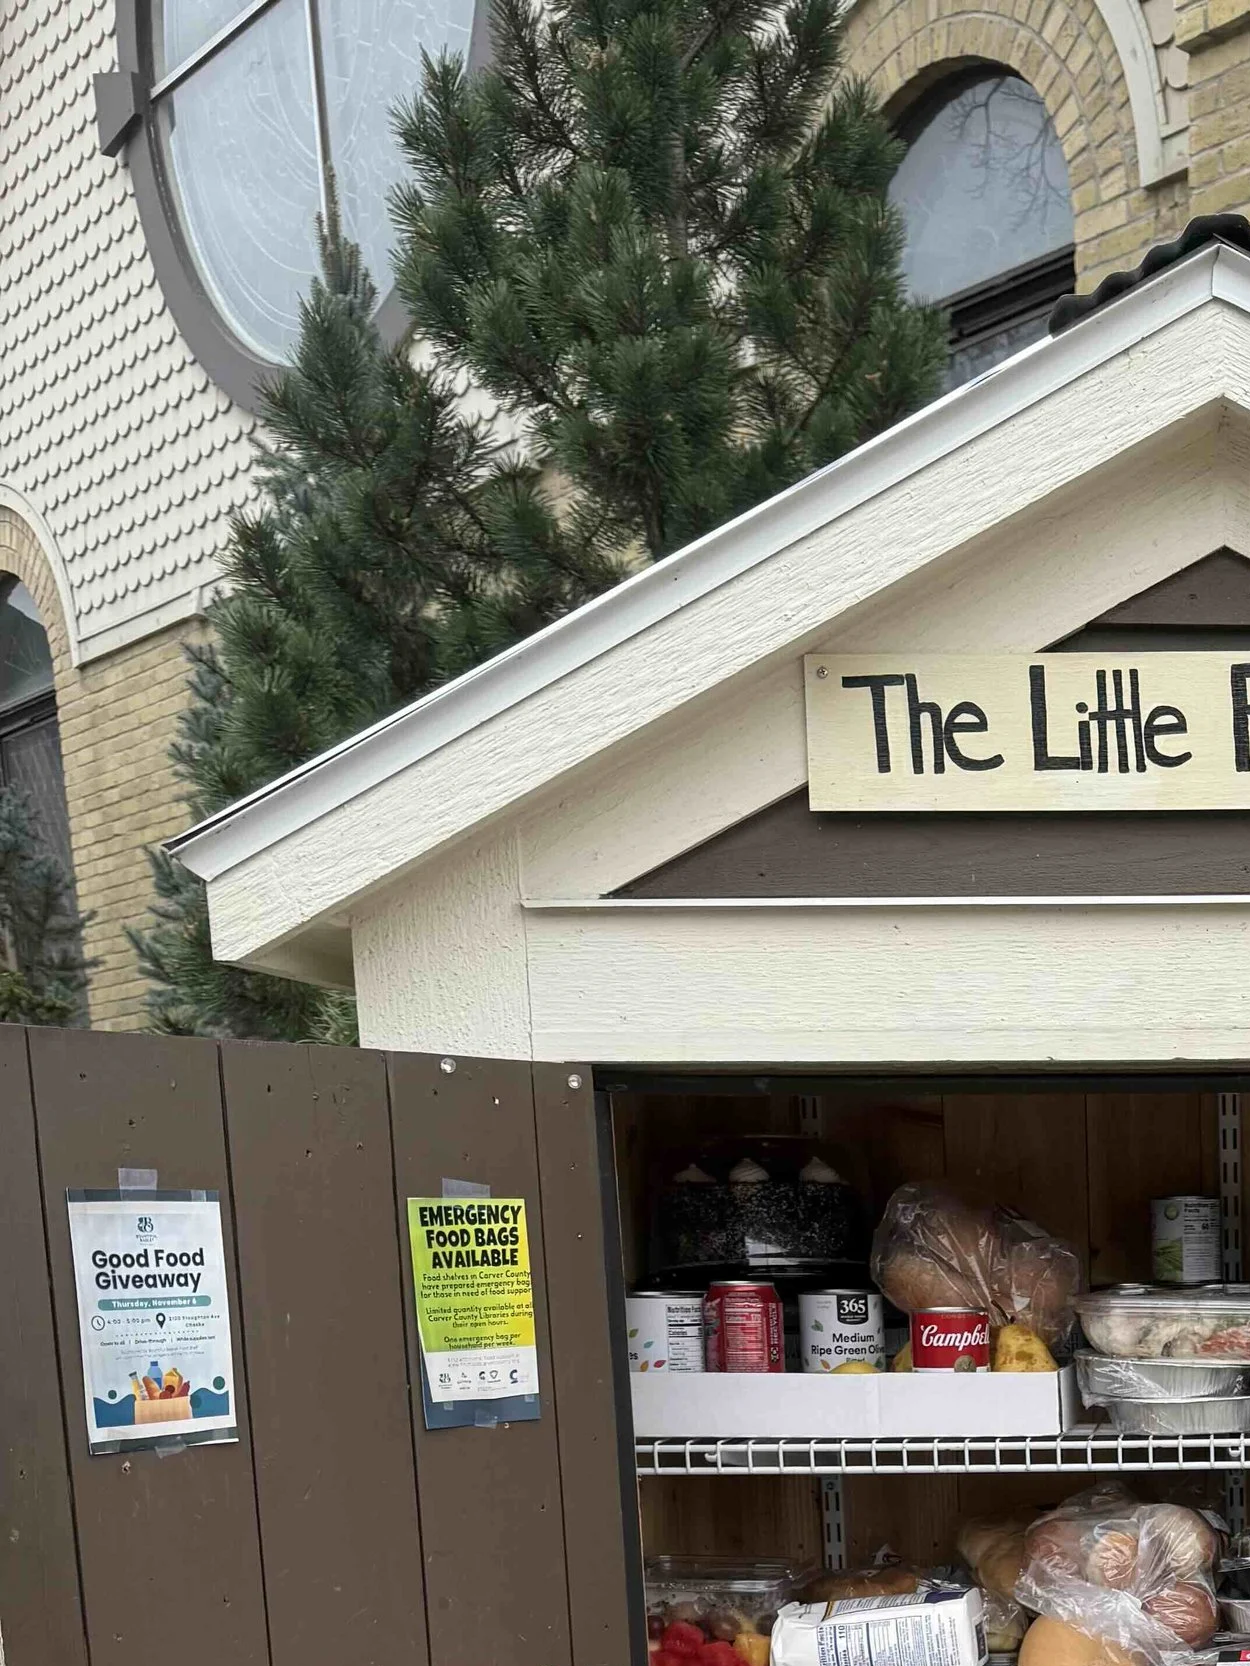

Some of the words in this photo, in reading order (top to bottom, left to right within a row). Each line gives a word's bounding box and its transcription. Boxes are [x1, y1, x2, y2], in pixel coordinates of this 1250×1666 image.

[842, 673, 1004, 774] The
[1030, 665, 1191, 773] Little
[419, 1205, 522, 1227] EMERGENCY
[426, 1229, 471, 1248] FOOD
[474, 1227, 519, 1246] BAGS
[92, 1249, 149, 1268] Good
[154, 1248, 204, 1267] Food
[432, 1248, 518, 1269] AVAILABLE
[95, 1270, 201, 1293] Giveaway
[505, 1270, 530, 1278] County
[442, 1281, 474, 1290] prepared
[476, 1280, 515, 1289] emergency
[454, 1305, 481, 1315] quantity
[840, 1299, 866, 1314] 365
[454, 1313, 477, 1321] County
[480, 1312, 509, 1320] Libraries
[511, 1310, 532, 1318] during
[459, 1335, 494, 1343] emergency
[496, 1333, 508, 1341] bag
[510, 1333, 521, 1341] per
[833, 1334, 874, 1342] Medium
[811, 1345, 832, 1355] Ripe
[834, 1345, 867, 1354] Green
[817, 1626, 825, 1647] Facts
